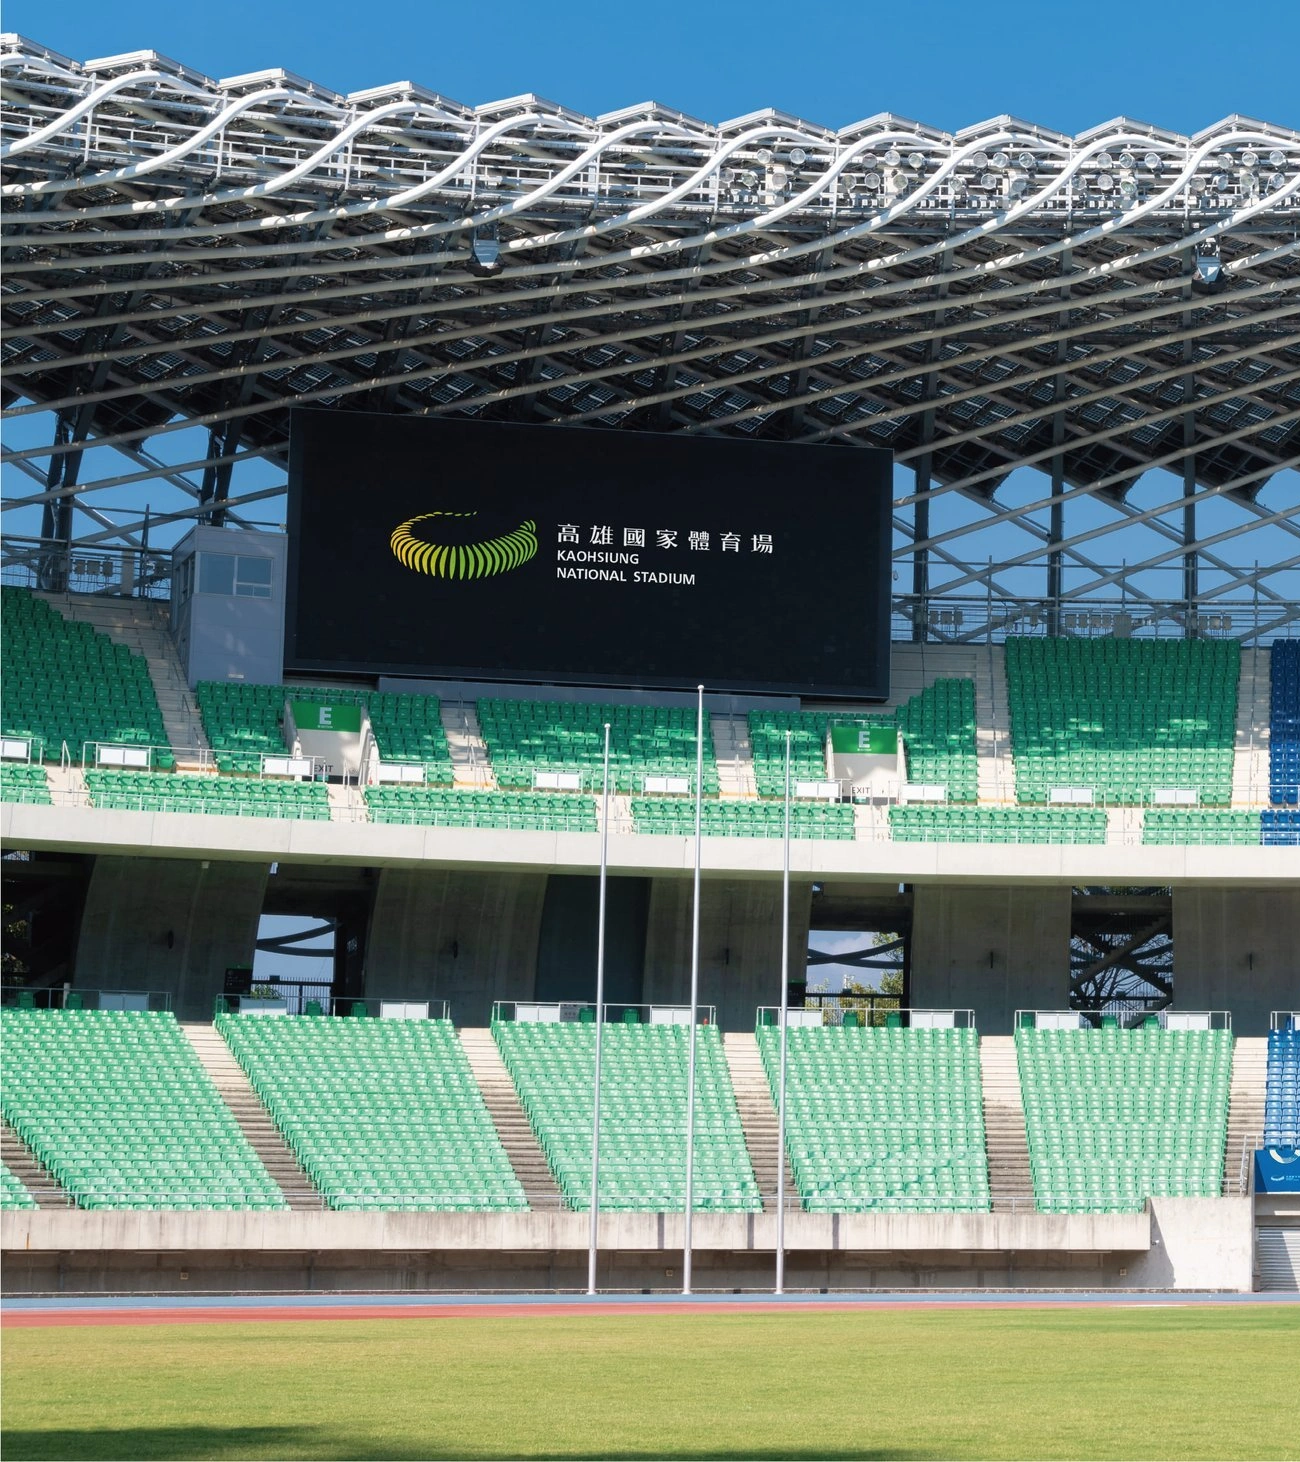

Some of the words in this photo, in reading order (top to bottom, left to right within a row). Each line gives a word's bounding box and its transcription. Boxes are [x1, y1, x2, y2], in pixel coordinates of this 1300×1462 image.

[557, 523, 773, 554] 高雄國家體育場
[557, 550, 639, 564] KAOHSIUNG
[556, 567, 627, 582] NATIONAL
[633, 571, 695, 585] STADIUM
[319, 706, 332, 725] E
[858, 731, 870, 748] E
